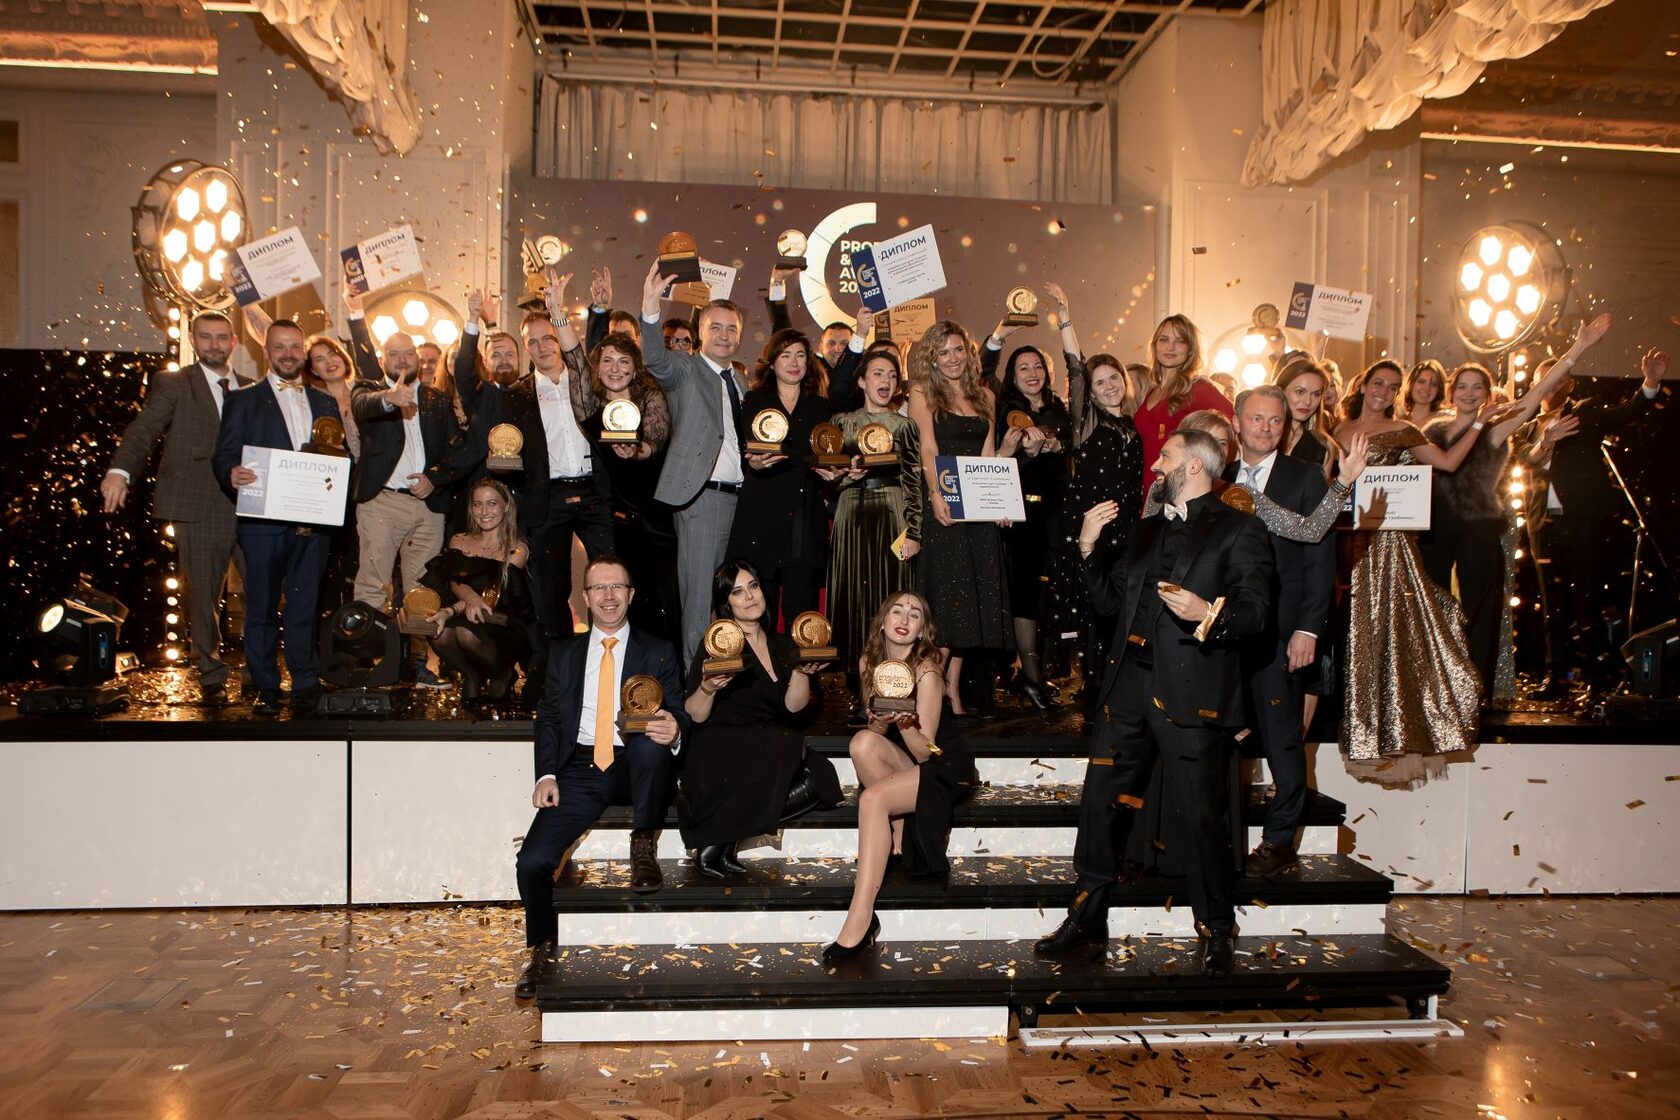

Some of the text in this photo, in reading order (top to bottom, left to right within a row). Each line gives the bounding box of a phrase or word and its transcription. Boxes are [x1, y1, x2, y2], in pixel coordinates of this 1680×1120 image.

[247, 236, 294, 260] ДИПЛОМ
[365, 233, 405, 255] ДИПЛОМ
[880, 235, 927, 261] ДИПЛОМ
[839, 280, 859, 293] 20
[863, 286, 881, 299] 2022
[1318, 291, 1363, 305] ДИПЛОМ
[894, 304, 928, 312] ДИПЛОМ
[278, 458, 338, 474] ДИПЛОМ
[965, 464, 1010, 474] ДИПЛОМ
[1364, 474, 1420, 484] ДИПЛОМ
[241, 488, 264, 497] 2022
